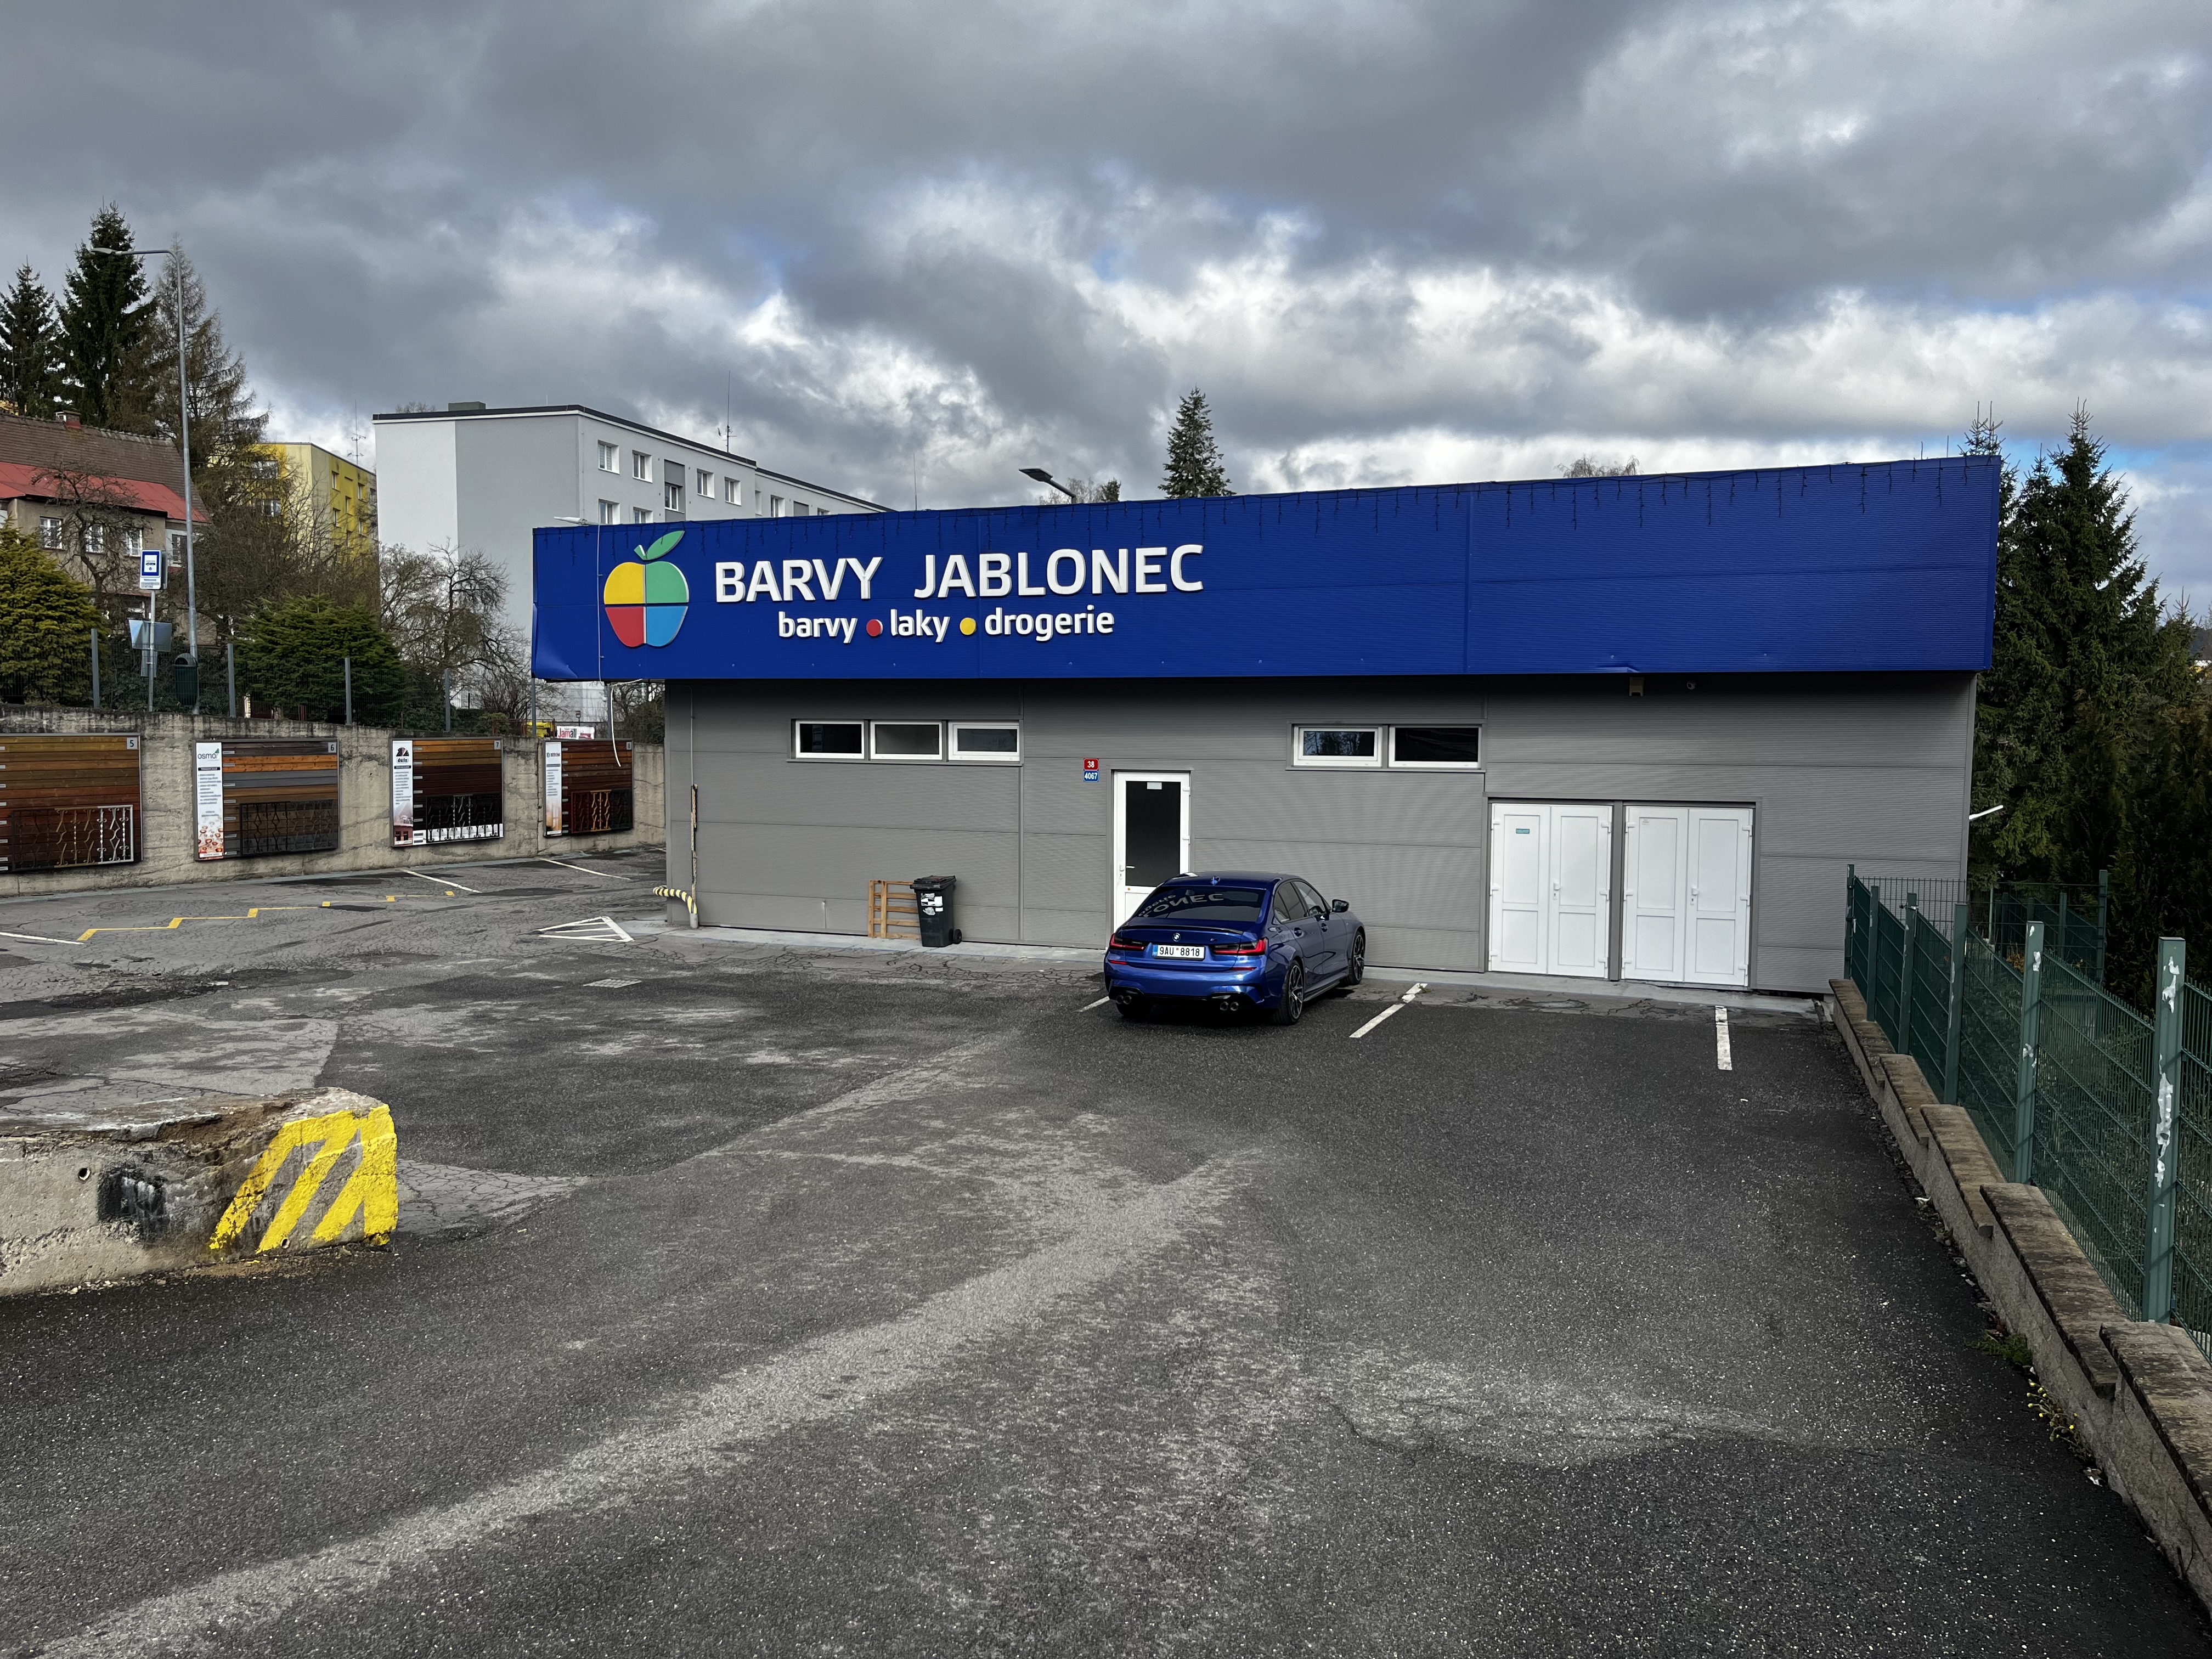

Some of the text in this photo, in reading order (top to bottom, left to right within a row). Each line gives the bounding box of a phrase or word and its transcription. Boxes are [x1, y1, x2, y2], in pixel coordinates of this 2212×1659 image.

[715, 544, 1204, 603] BARVY JABLONEC
[778, 605, 1114, 644] barvy laky drogerie
[129, 740, 134, 748] 5
[1159, 946, 1200, 956] 9AU 8818
